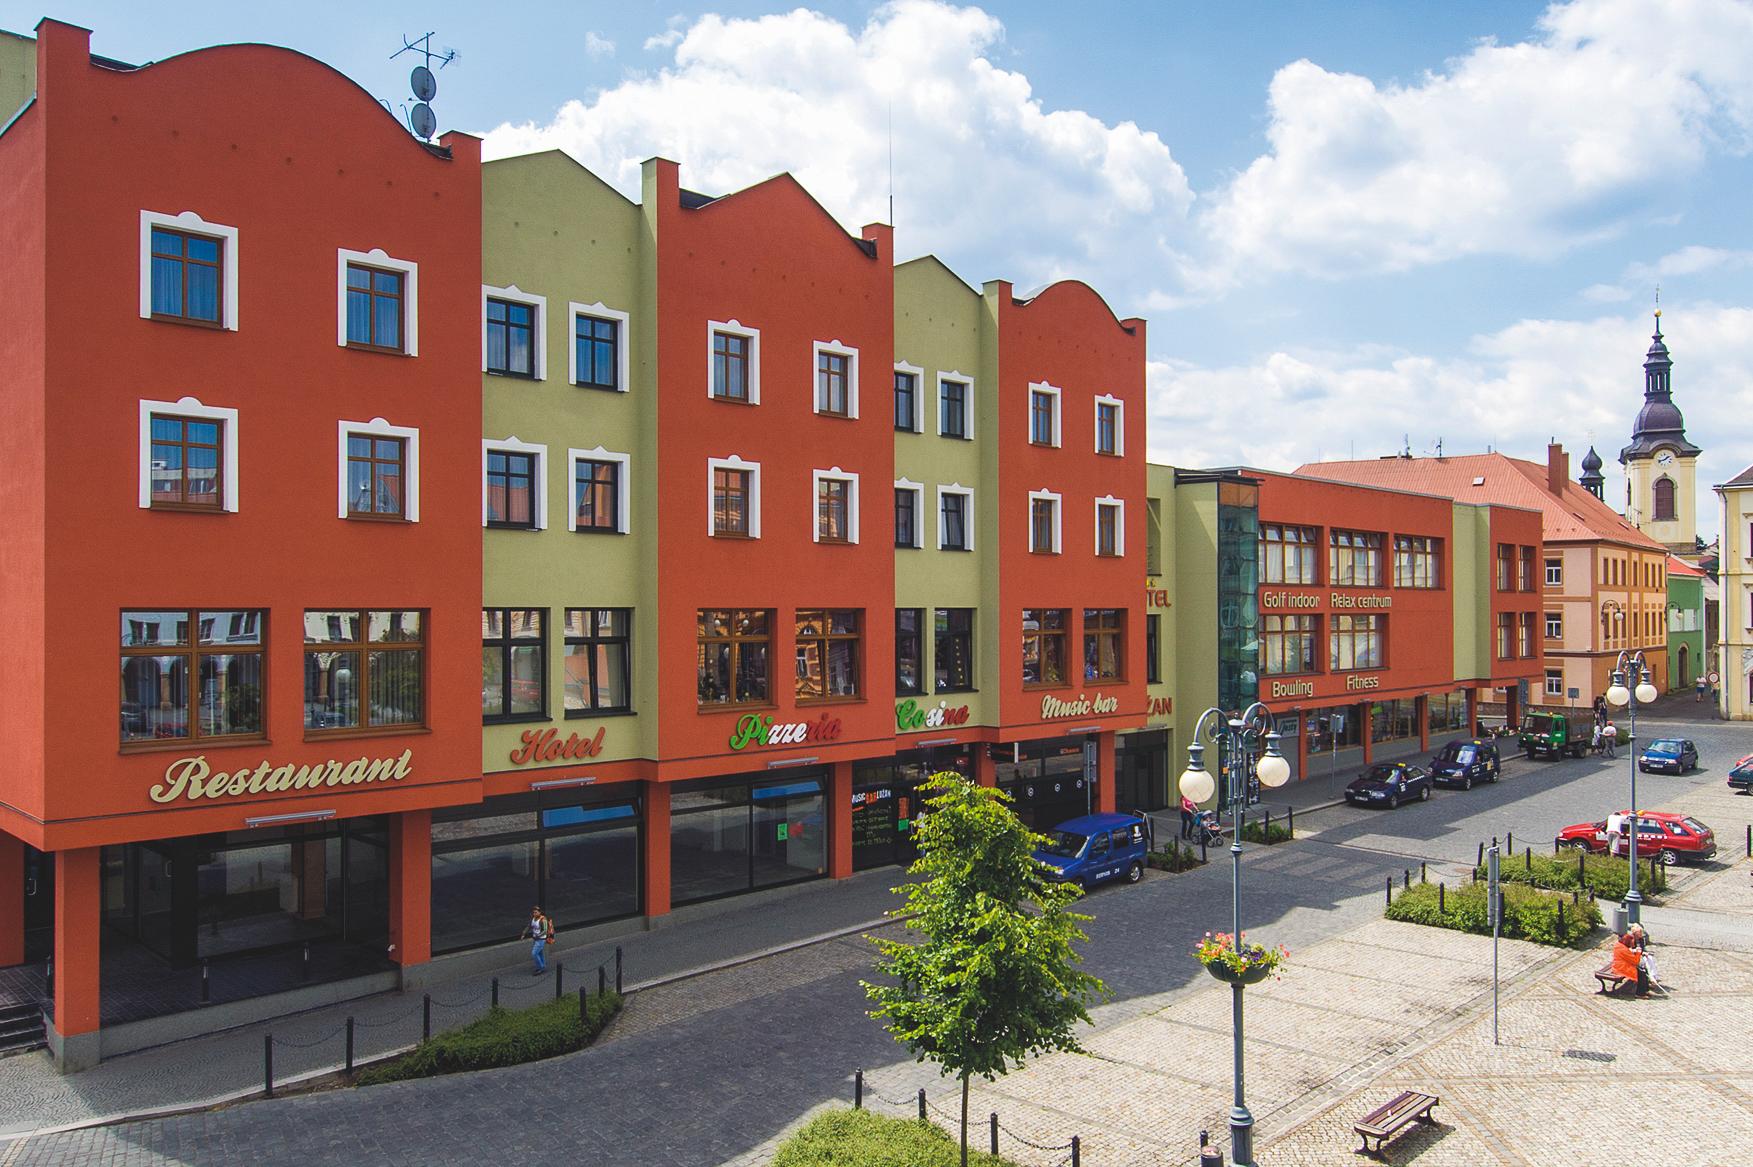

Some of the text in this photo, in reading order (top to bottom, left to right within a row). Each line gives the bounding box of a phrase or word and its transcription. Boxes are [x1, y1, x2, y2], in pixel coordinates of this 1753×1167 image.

[1263, 591, 1320, 608] Golf indoor
[1331, 592, 1392, 608] Relax centrum
[1272, 680, 1314, 698] Bowling
[1346, 674, 1379, 690] Fitness
[896, 699, 970, 731] Cosina
[1041, 692, 1118, 719] Music bar
[729, 711, 842, 750] Pizzeria
[510, 726, 606, 765] Hotel
[150, 748, 413, 803] Restaurant
